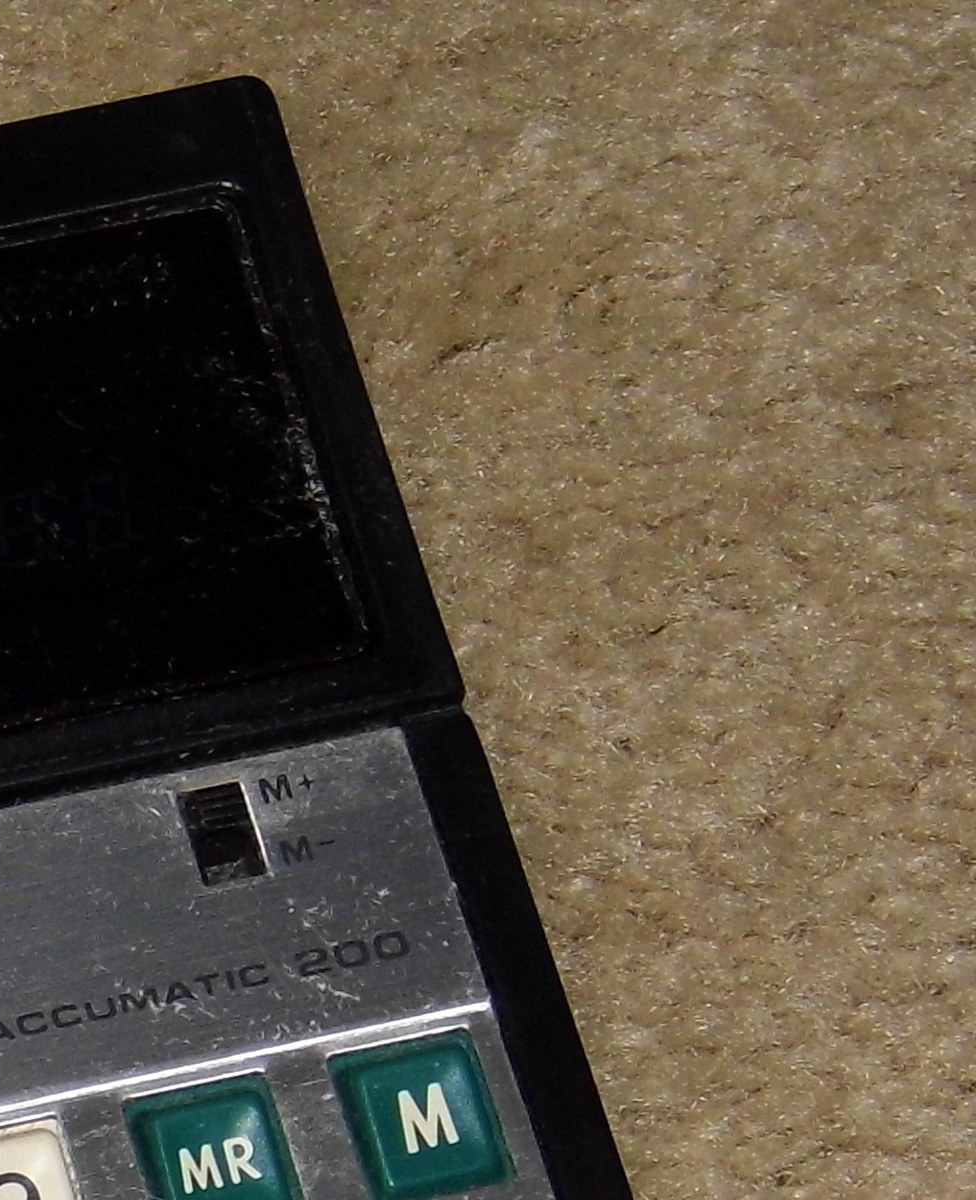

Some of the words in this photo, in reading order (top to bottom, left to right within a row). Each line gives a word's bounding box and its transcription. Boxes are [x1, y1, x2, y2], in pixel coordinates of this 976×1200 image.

[295, 931, 412, 977] 200
[398, 1083, 460, 1154] M
[179, 1136, 262, 1193] MR
